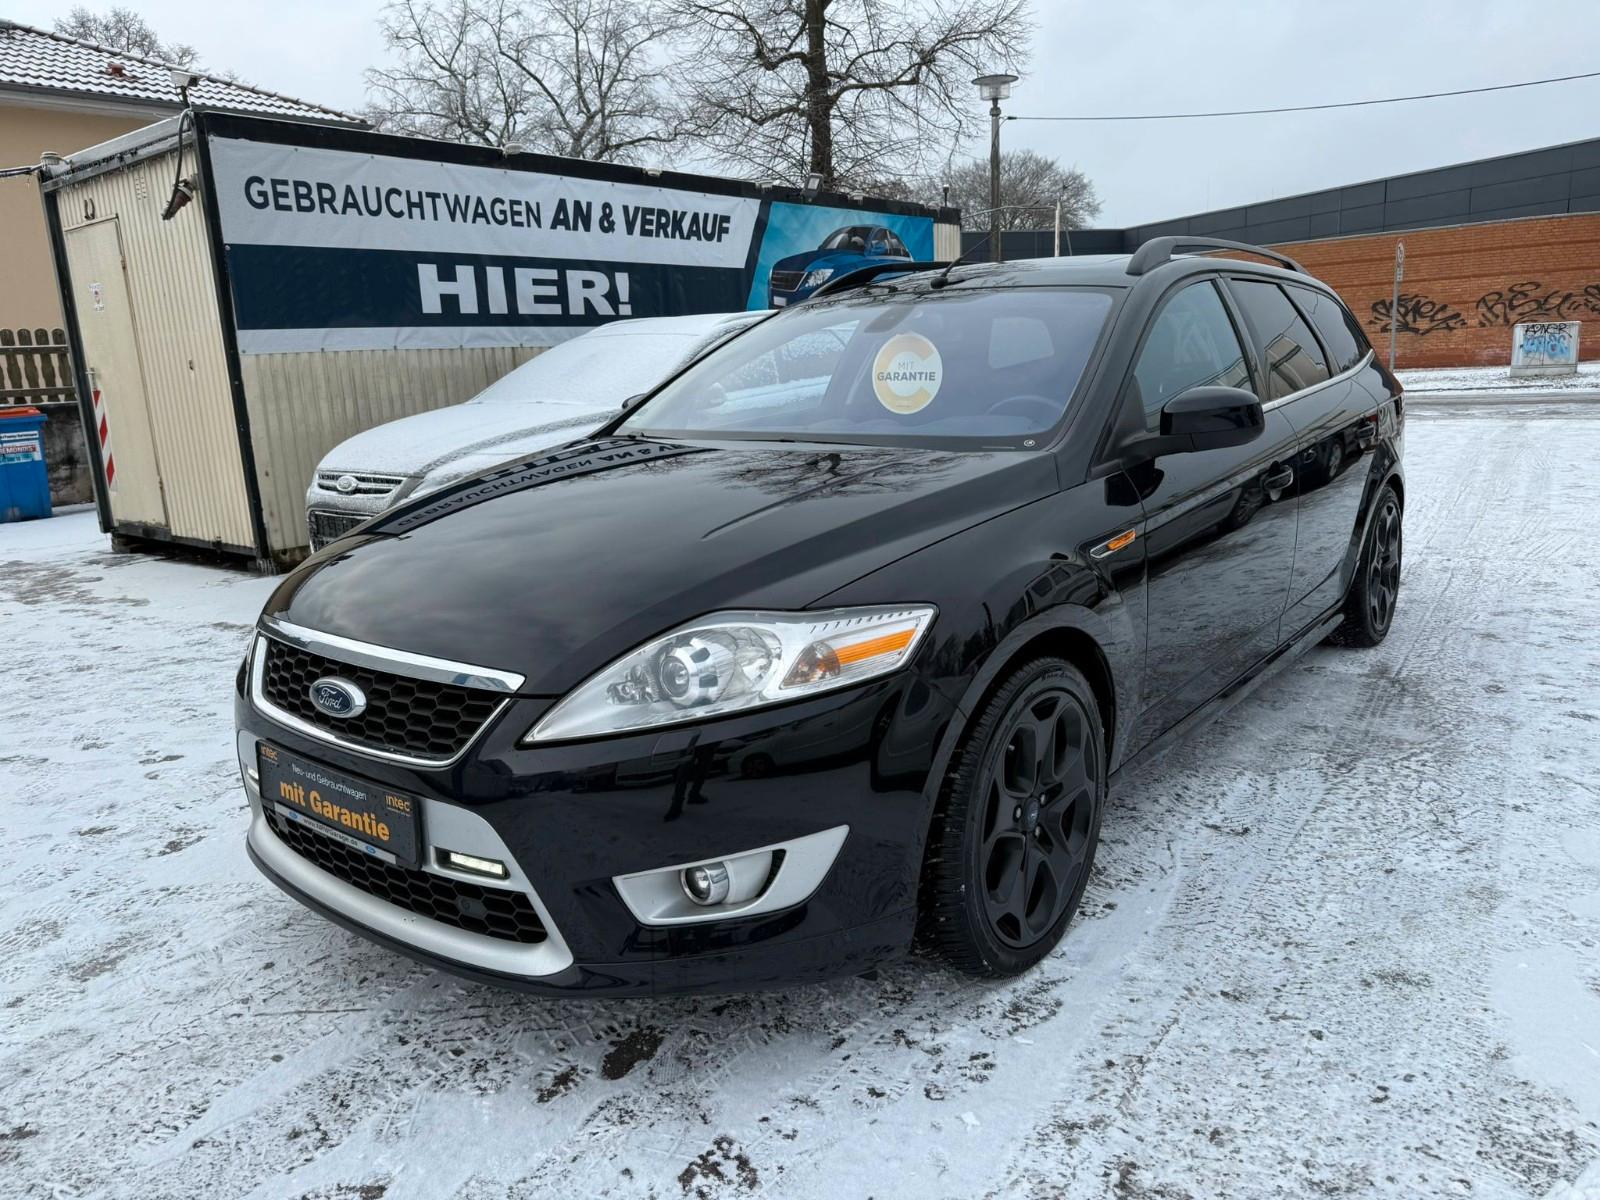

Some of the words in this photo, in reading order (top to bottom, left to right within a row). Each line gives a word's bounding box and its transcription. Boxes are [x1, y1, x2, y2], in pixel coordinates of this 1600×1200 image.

[244, 175, 543, 229] GEBRAUCHTWAGEN
[550, 198, 592, 233] AN
[599, 202, 616, 234] &
[622, 204, 731, 243] VERKAUF
[417, 263, 633, 316] HIER!
[877, 371, 937, 382] GARANTIE
[898, 361, 915, 371] MIT
[319, 687, 342, 709] Ford
[291, 762, 305, 777] Neu-
[305, 771, 316, 782] und
[316, 774, 367, 801] Gebrauchtwagen
[280, 781, 306, 808] mit
[309, 790, 391, 841] Garantie
[385, 795, 410, 811] intec
